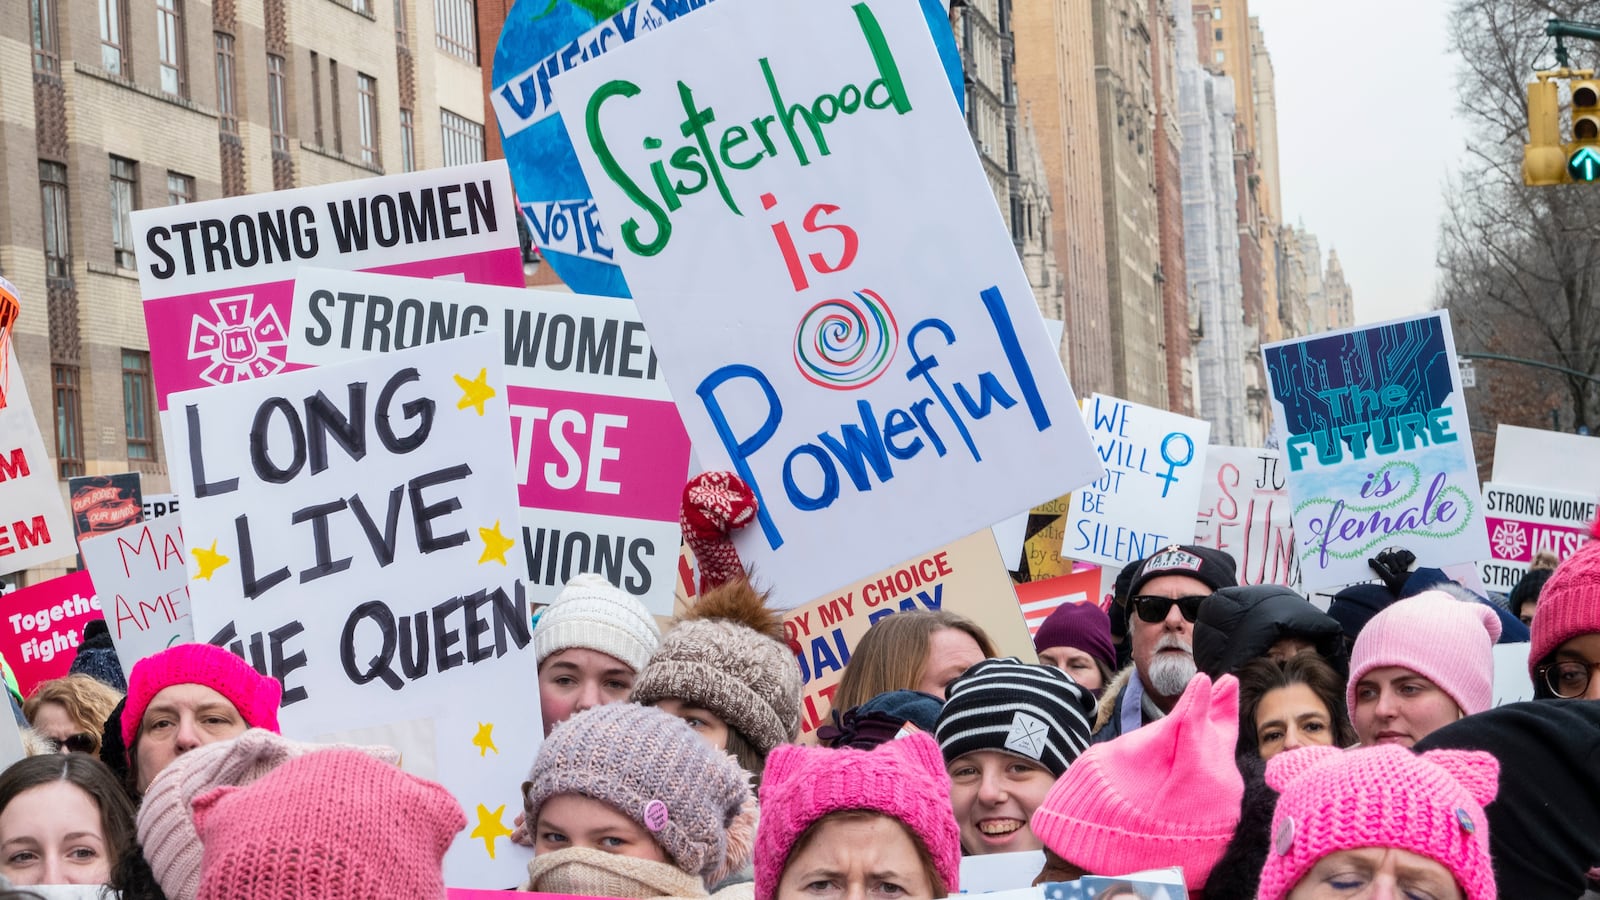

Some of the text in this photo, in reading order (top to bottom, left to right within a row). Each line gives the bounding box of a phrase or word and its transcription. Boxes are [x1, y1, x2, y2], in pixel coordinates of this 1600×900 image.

[642, 10, 662, 31] the
[585, 3, 912, 257] Sisterhood
[146, 180, 498, 279] STRONG WOMEN
[523, 201, 613, 260] VOTE
[760, 192, 859, 291] is
[504, 309, 658, 380] WOME
[695, 285, 1052, 551] Powerful
[1094, 397, 1133, 438] WE
[1318, 384, 1408, 418] The
[186, 367, 435, 498] LONG
[509, 404, 628, 495] TSE
[1286, 406, 1458, 472] FUTURE
[73, 487, 116, 511] OUR BODIES
[1081, 491, 1105, 514] BE
[1360, 470, 1400, 498] is
[1487, 491, 1545, 516] STRONG
[90, 504, 134, 522] OUR MINDS
[235, 463, 473, 599] LIVE
[1304, 472, 1458, 569] female
[117, 525, 184, 578] MA
[1030, 543, 1047, 565] by
[1074, 519, 1169, 563] SILENT
[1147, 552, 1197, 568] IATSE
[115, 585, 190, 640] AME
[817, 592, 855, 628] MY
[862, 551, 953, 607] CHOICE
[20, 627, 78, 664] Fight
[340, 579, 532, 690] QUEEN
